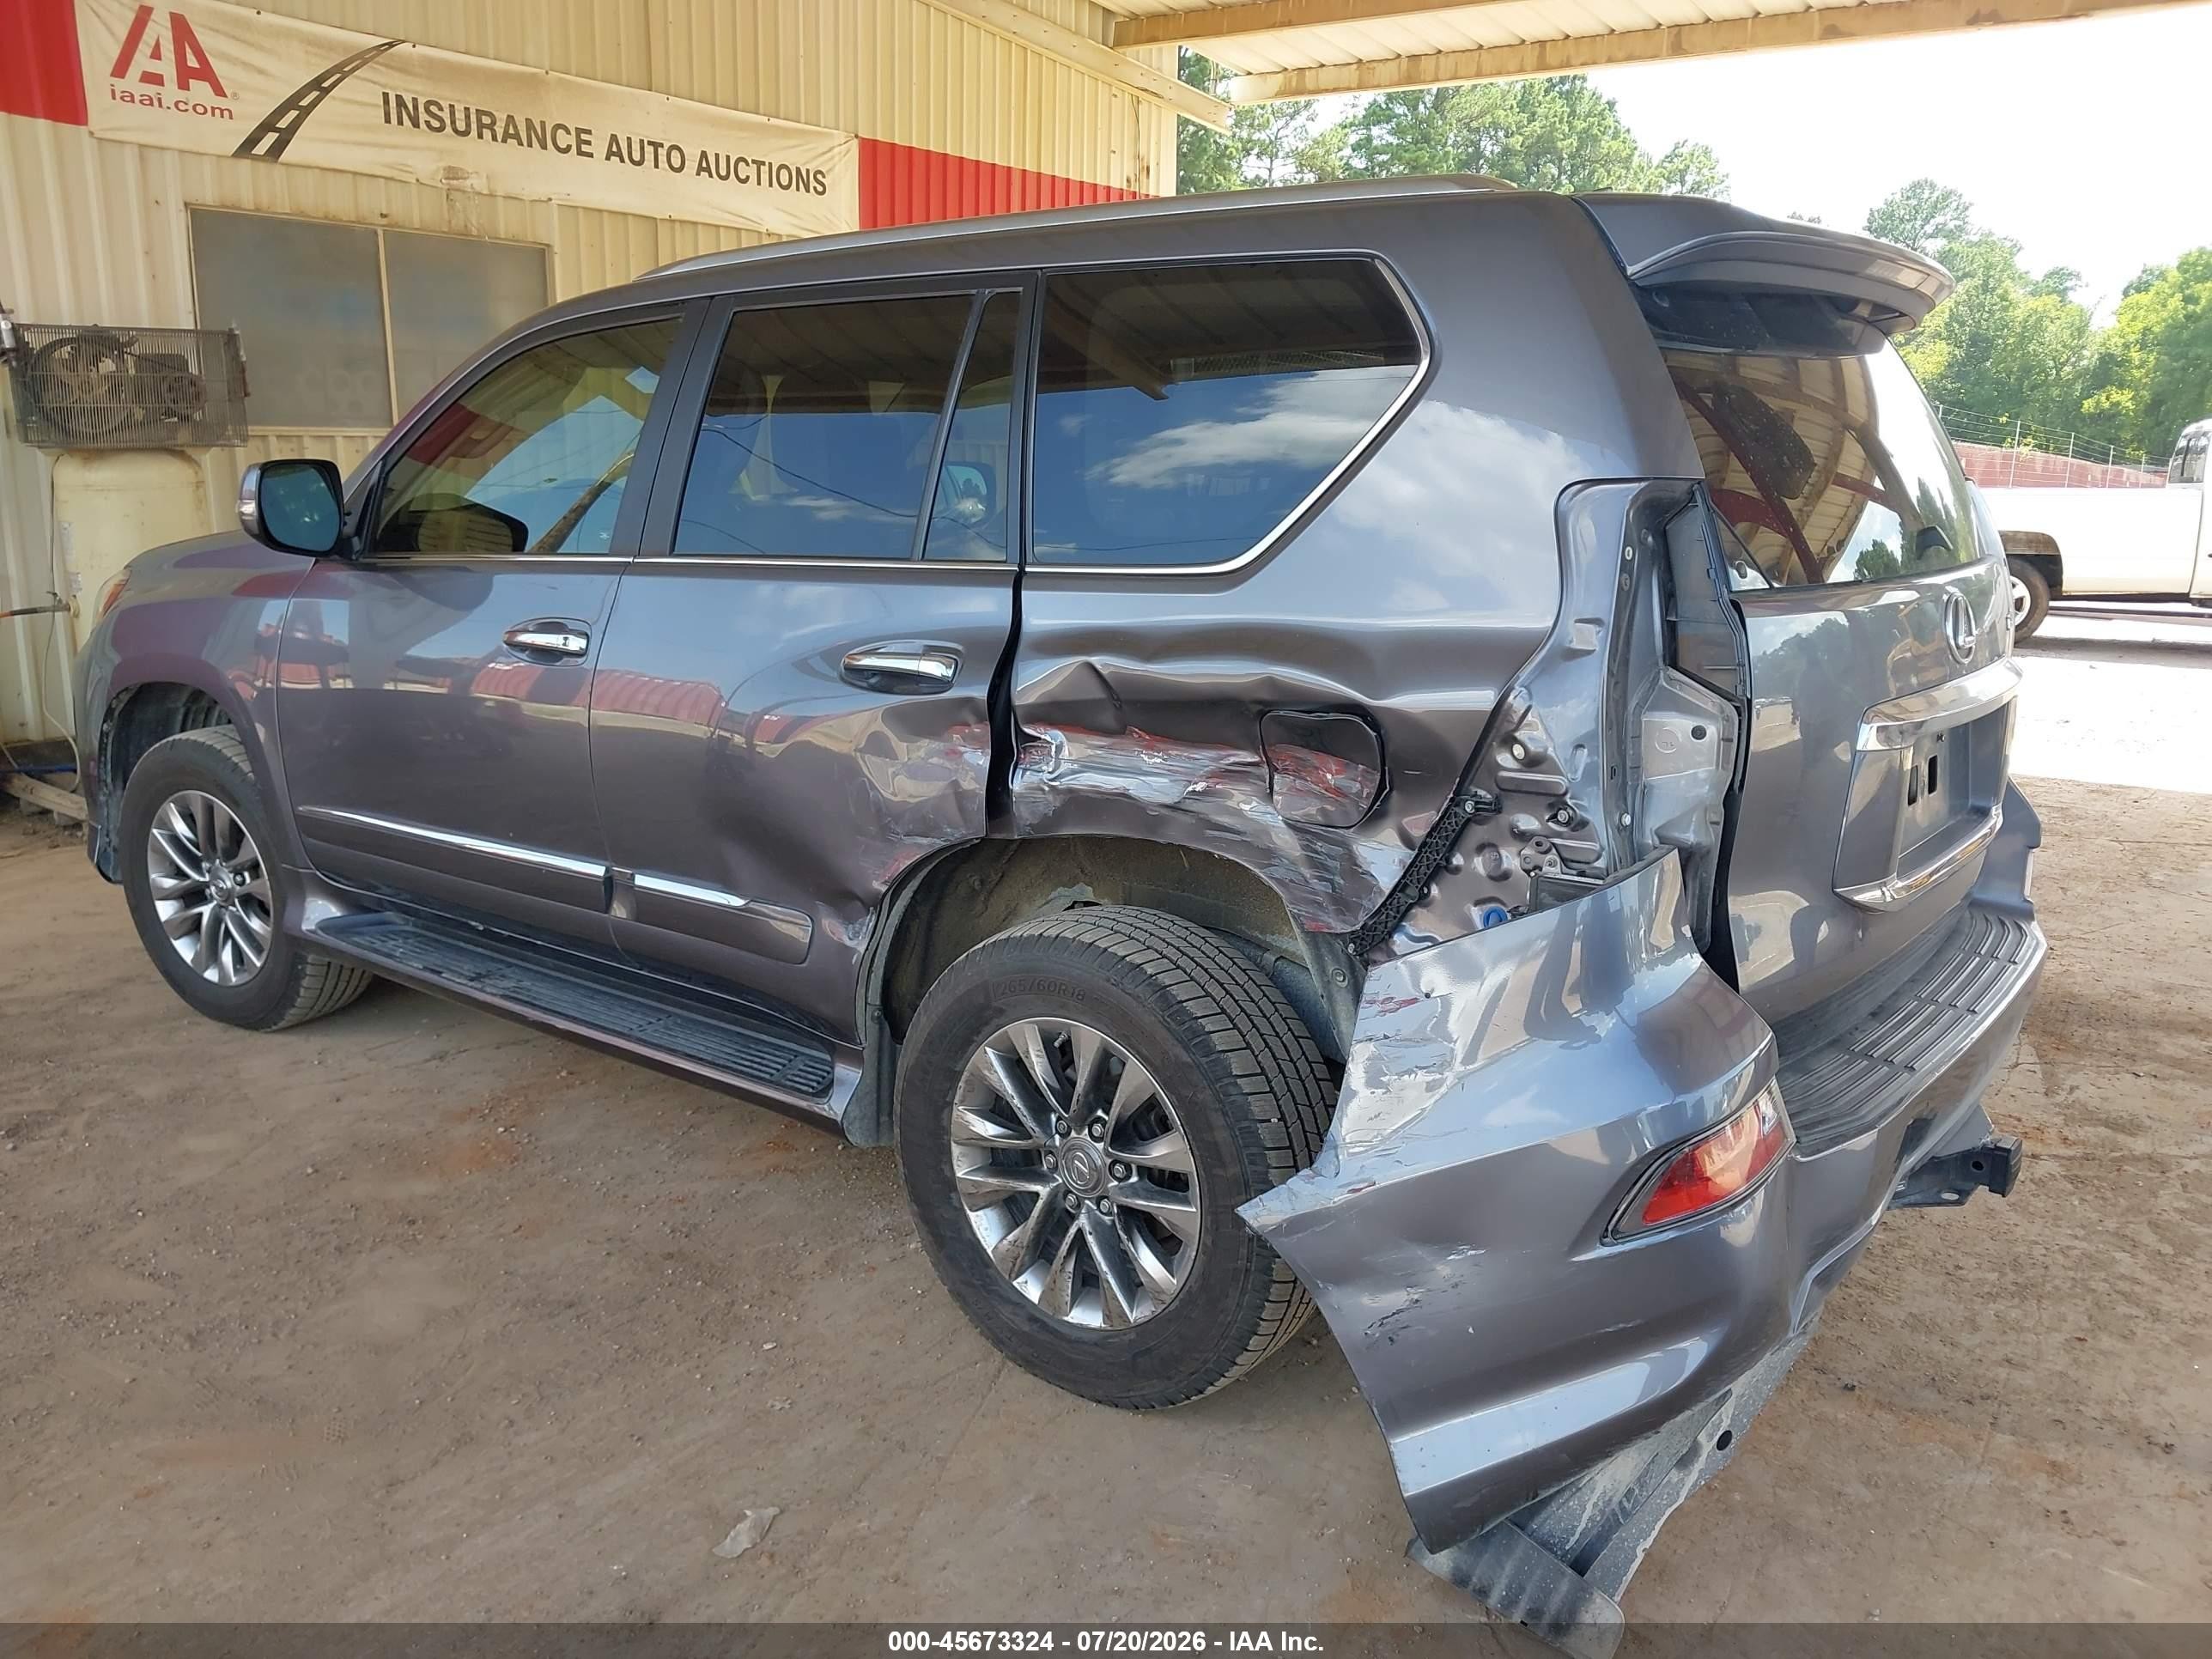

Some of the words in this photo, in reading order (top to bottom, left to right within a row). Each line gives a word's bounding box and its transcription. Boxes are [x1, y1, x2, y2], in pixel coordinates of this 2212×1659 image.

[110, 4, 228, 99] IAA
[110, 83, 234, 120] iaai.com
[381, 91, 594, 159] INSURANCE
[605, 133, 687, 173] AUTO
[695, 149, 827, 197] AUCTIONS
